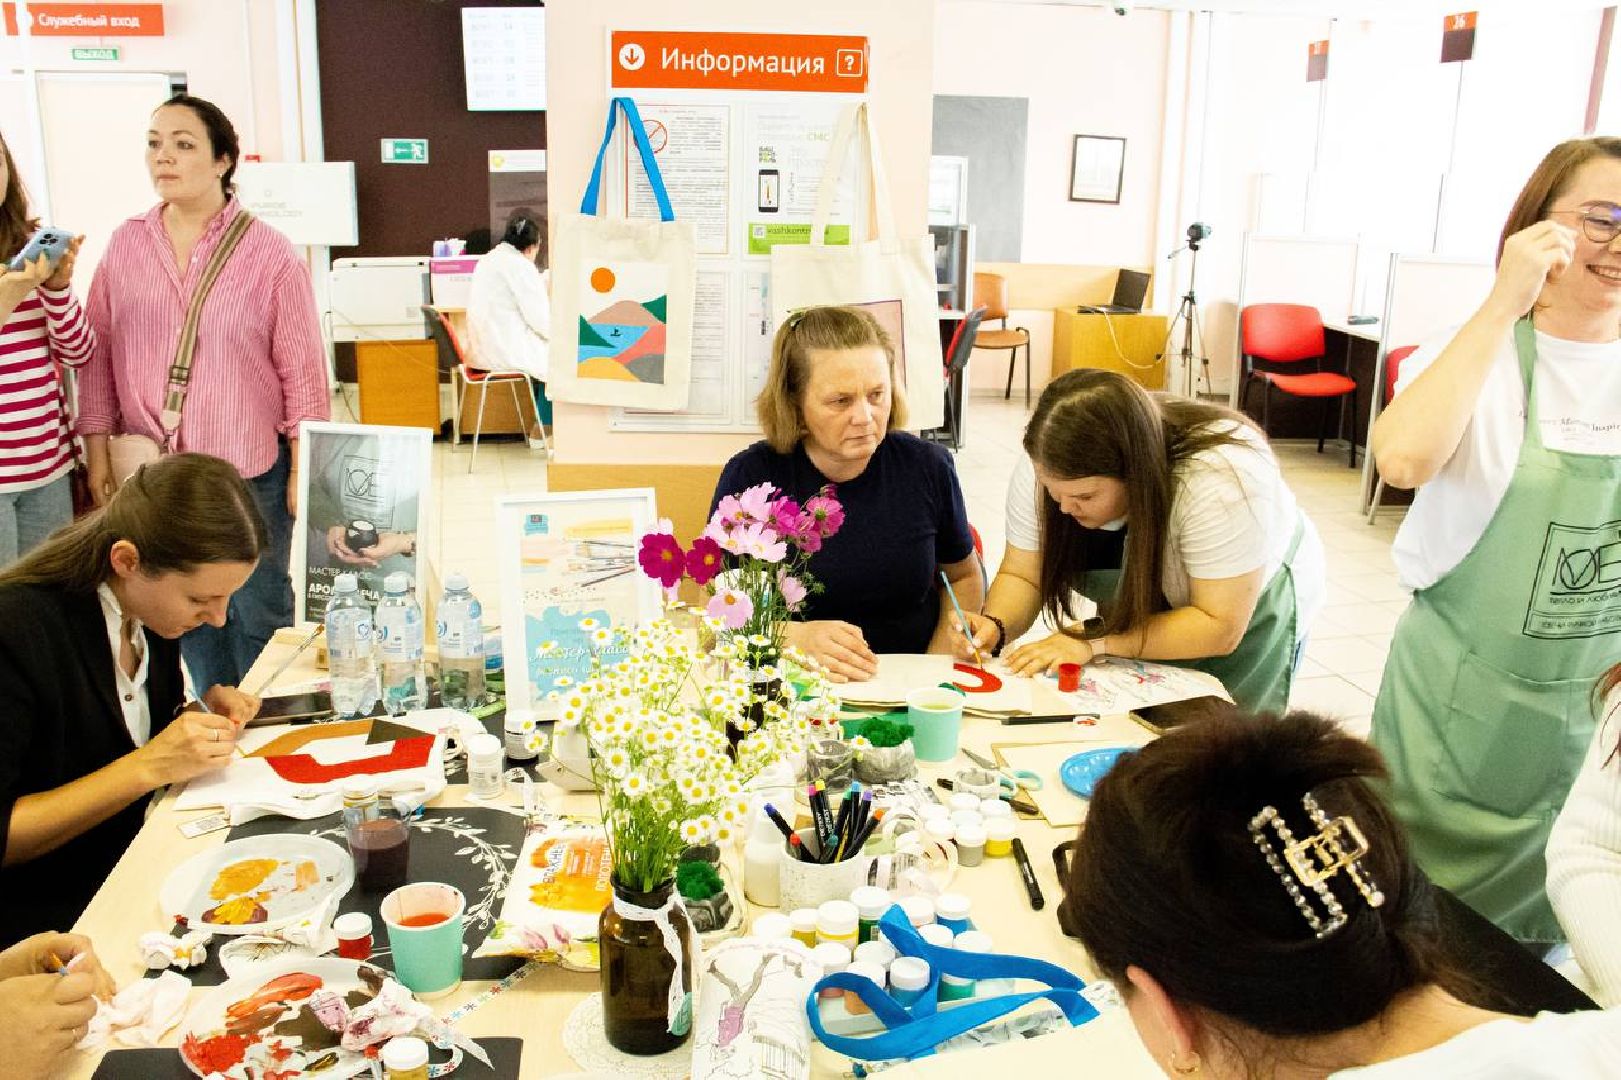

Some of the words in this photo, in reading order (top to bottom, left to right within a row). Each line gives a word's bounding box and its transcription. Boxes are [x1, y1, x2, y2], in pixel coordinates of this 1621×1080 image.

[38, 13, 108, 29] Служебный
[110, 16, 141, 28] вход
[661, 47, 826, 78] Информация
